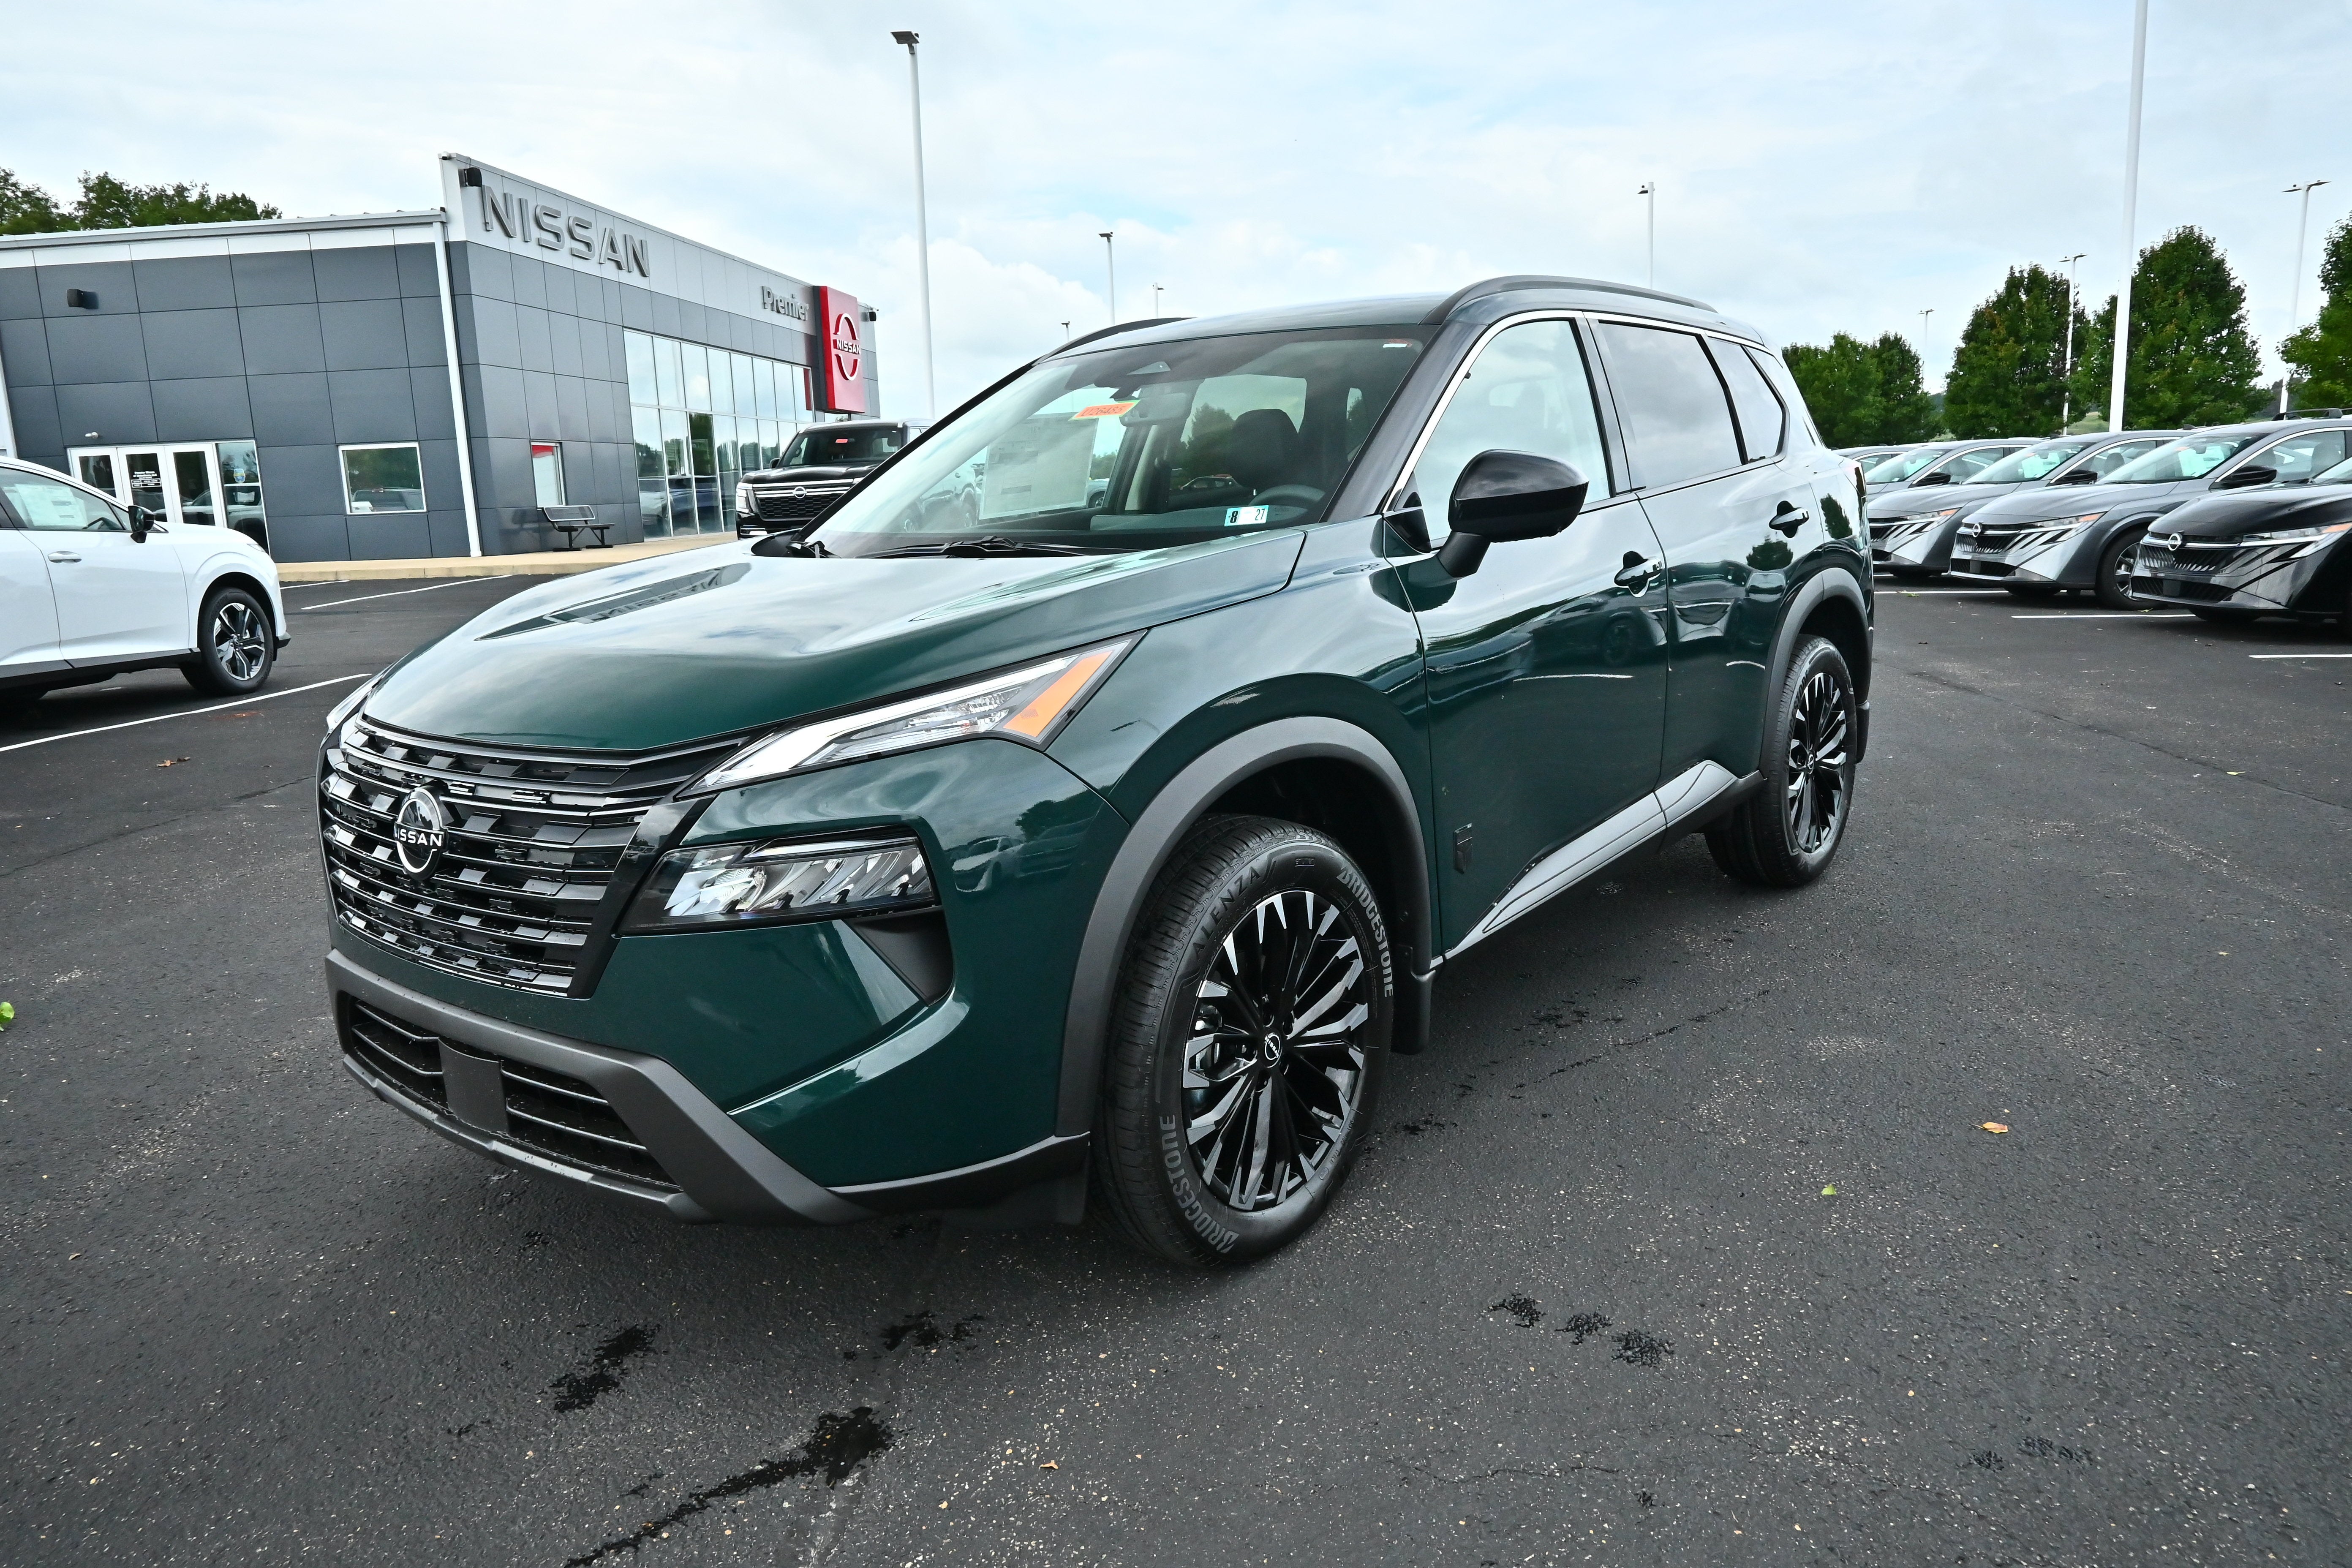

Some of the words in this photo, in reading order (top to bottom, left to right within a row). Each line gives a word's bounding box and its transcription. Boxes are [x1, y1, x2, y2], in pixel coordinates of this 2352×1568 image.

[481, 185, 651, 278] NISSAN
[761, 286, 809, 321] Premier
[836, 339, 861, 355] NISSAN
[1255, 508, 1266, 521] 27
[1192, 866, 1261, 962] ALENZA
[1336, 866, 1394, 998] BRIDGESTONE
[1160, 1114, 1240, 1254] BRIDGESTONE
